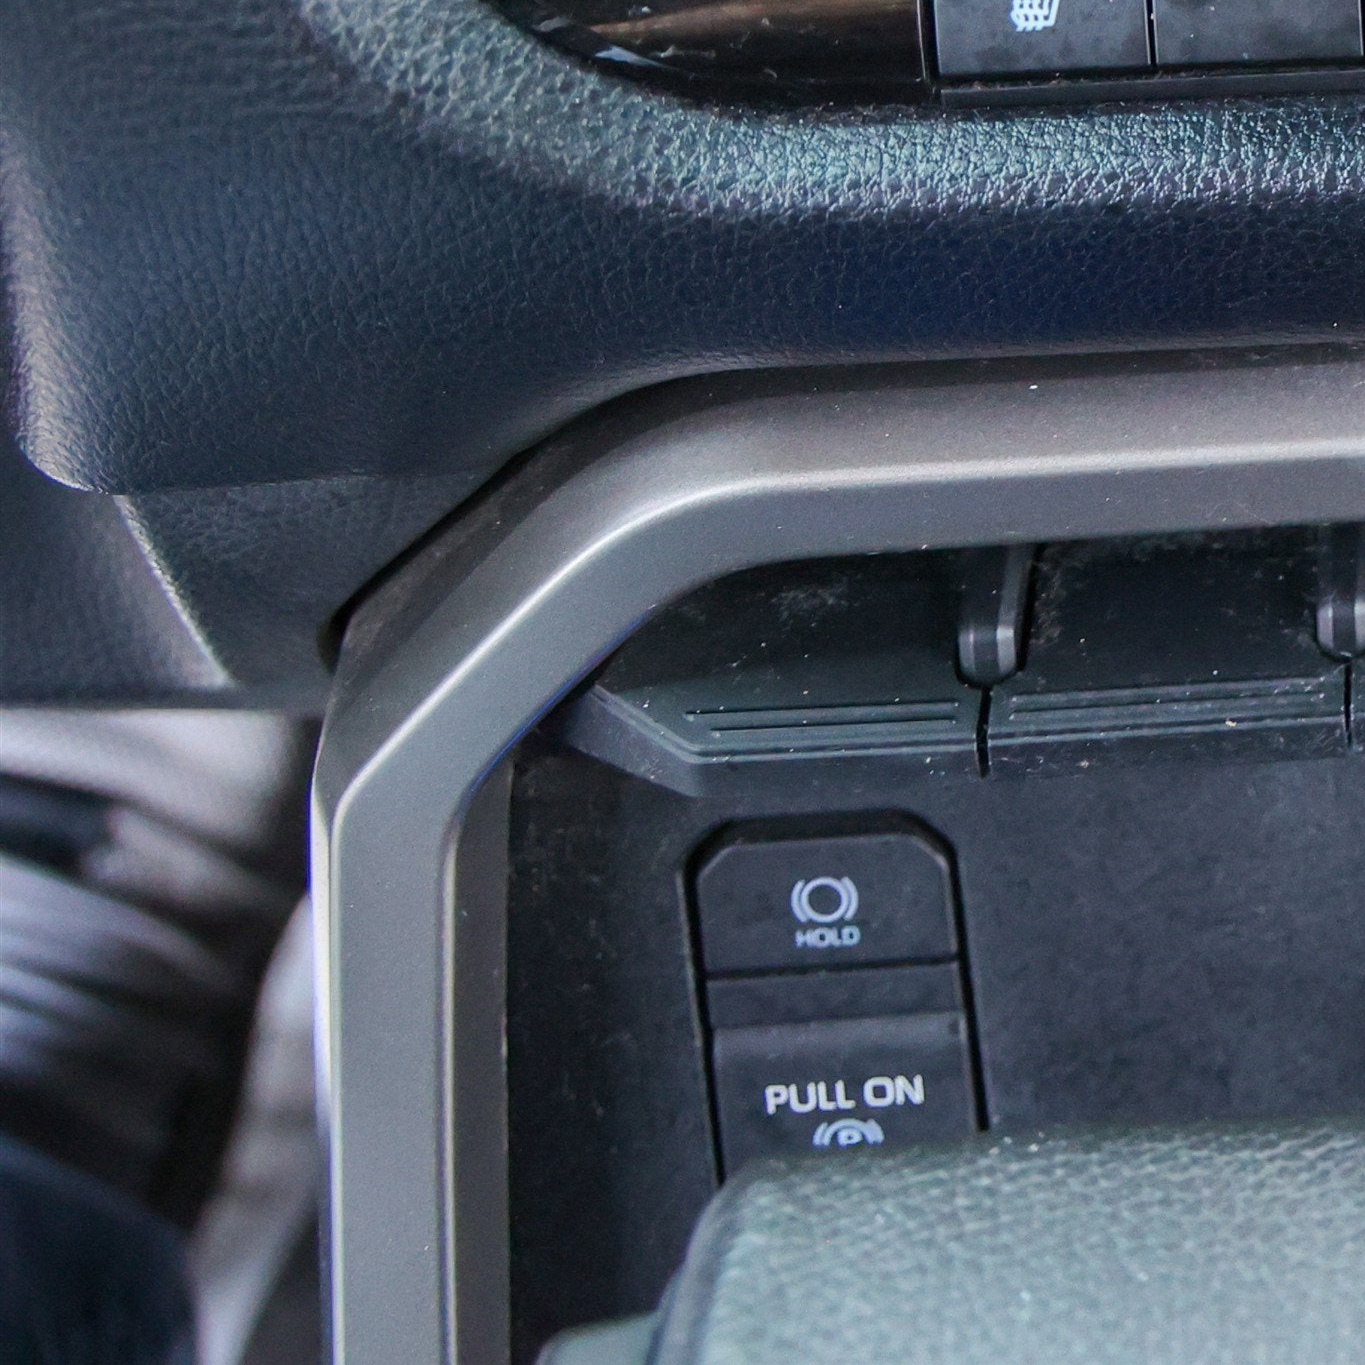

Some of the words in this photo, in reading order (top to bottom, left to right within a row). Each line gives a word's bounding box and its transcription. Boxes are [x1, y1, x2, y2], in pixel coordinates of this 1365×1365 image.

[795, 924, 861, 947] HOLD
[764, 1079, 856, 1115] PULL
[863, 1074, 925, 1107] ON
